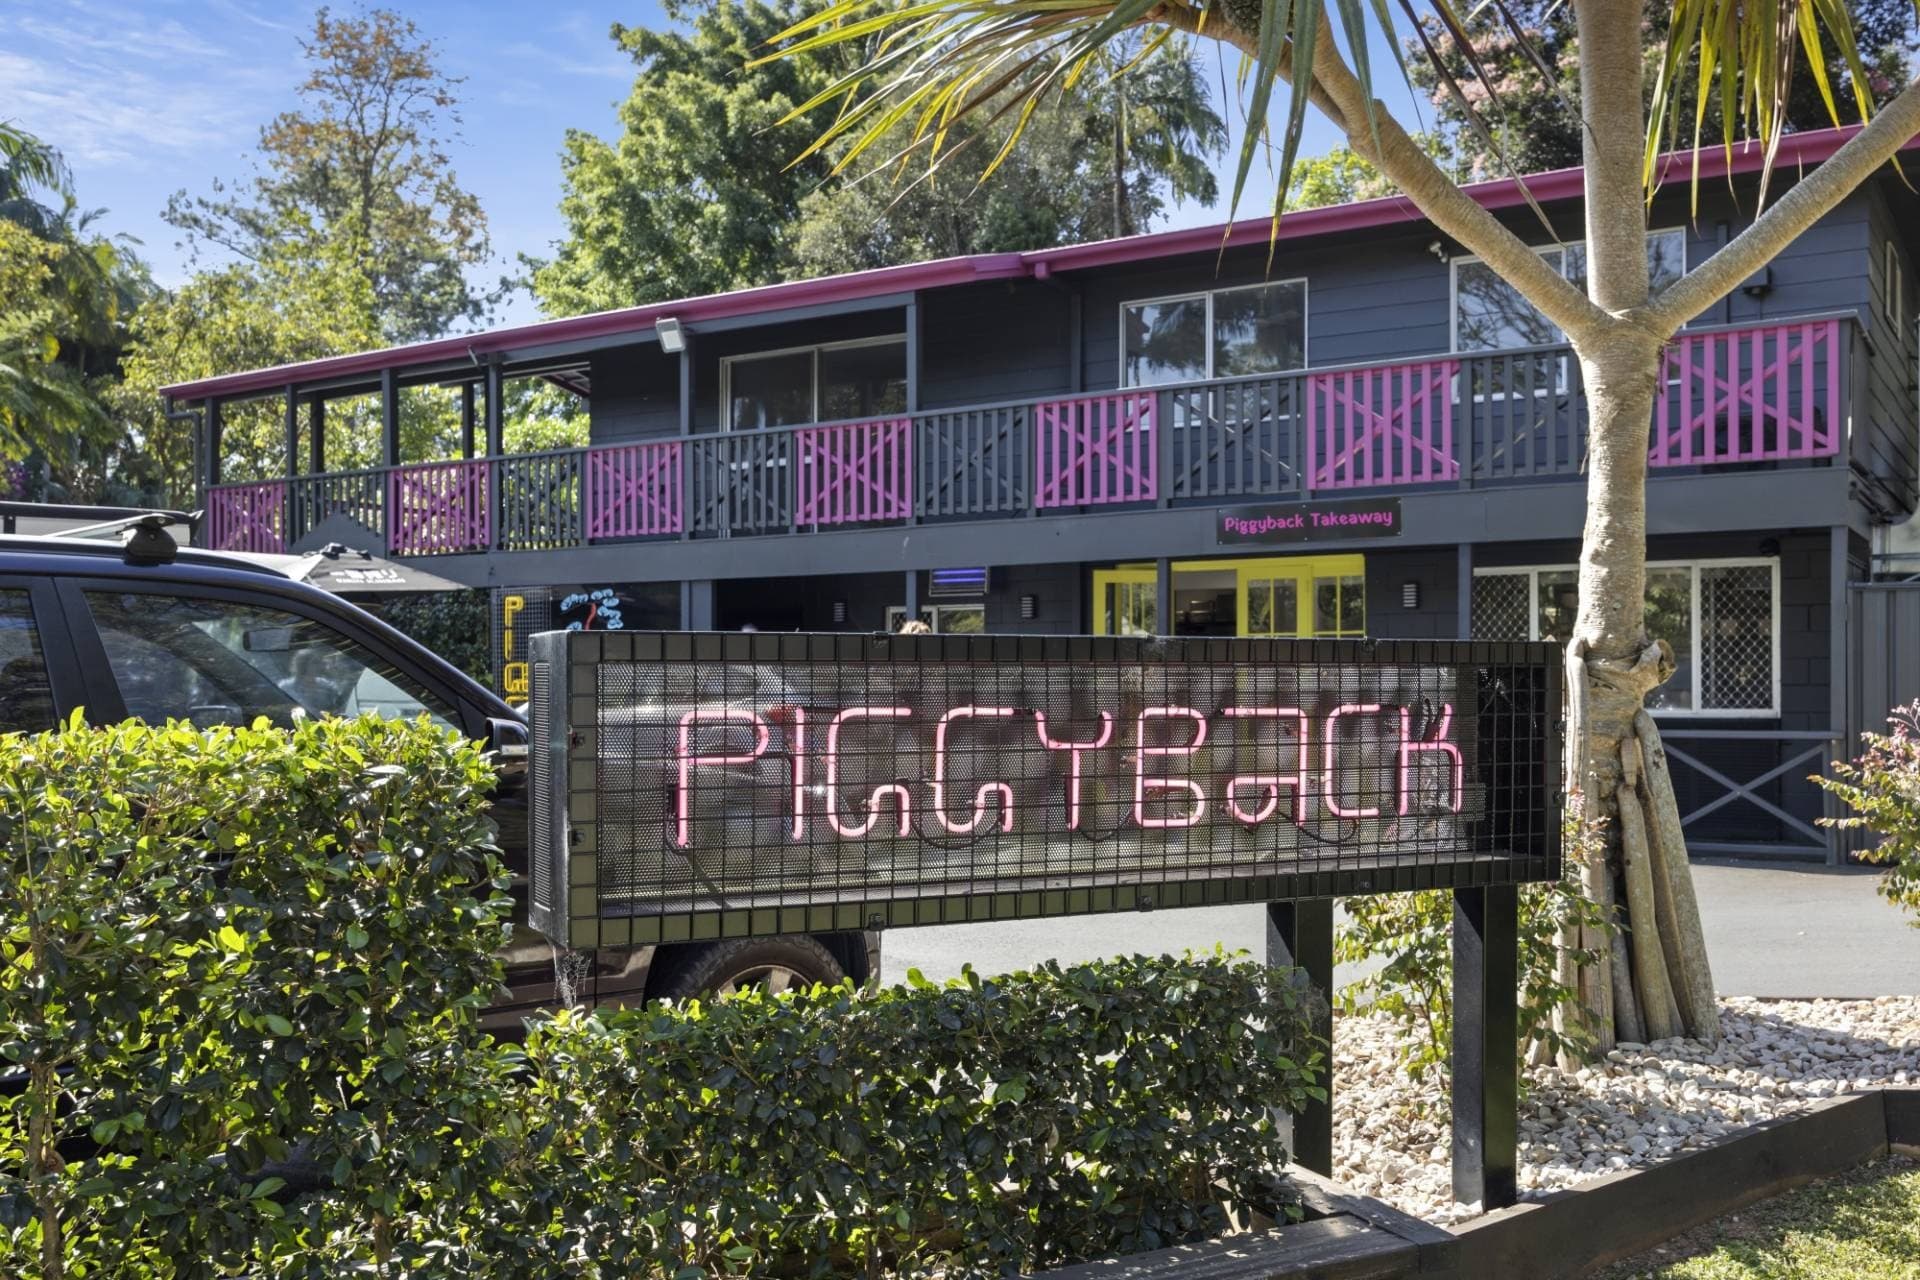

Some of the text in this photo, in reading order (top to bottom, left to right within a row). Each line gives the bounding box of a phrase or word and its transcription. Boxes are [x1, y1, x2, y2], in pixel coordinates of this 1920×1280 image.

[1224, 511, 1393, 535] Piggyback Takeaway
[504, 596, 529, 704] PIG
[677, 703, 1463, 847] PIGGYBACK
